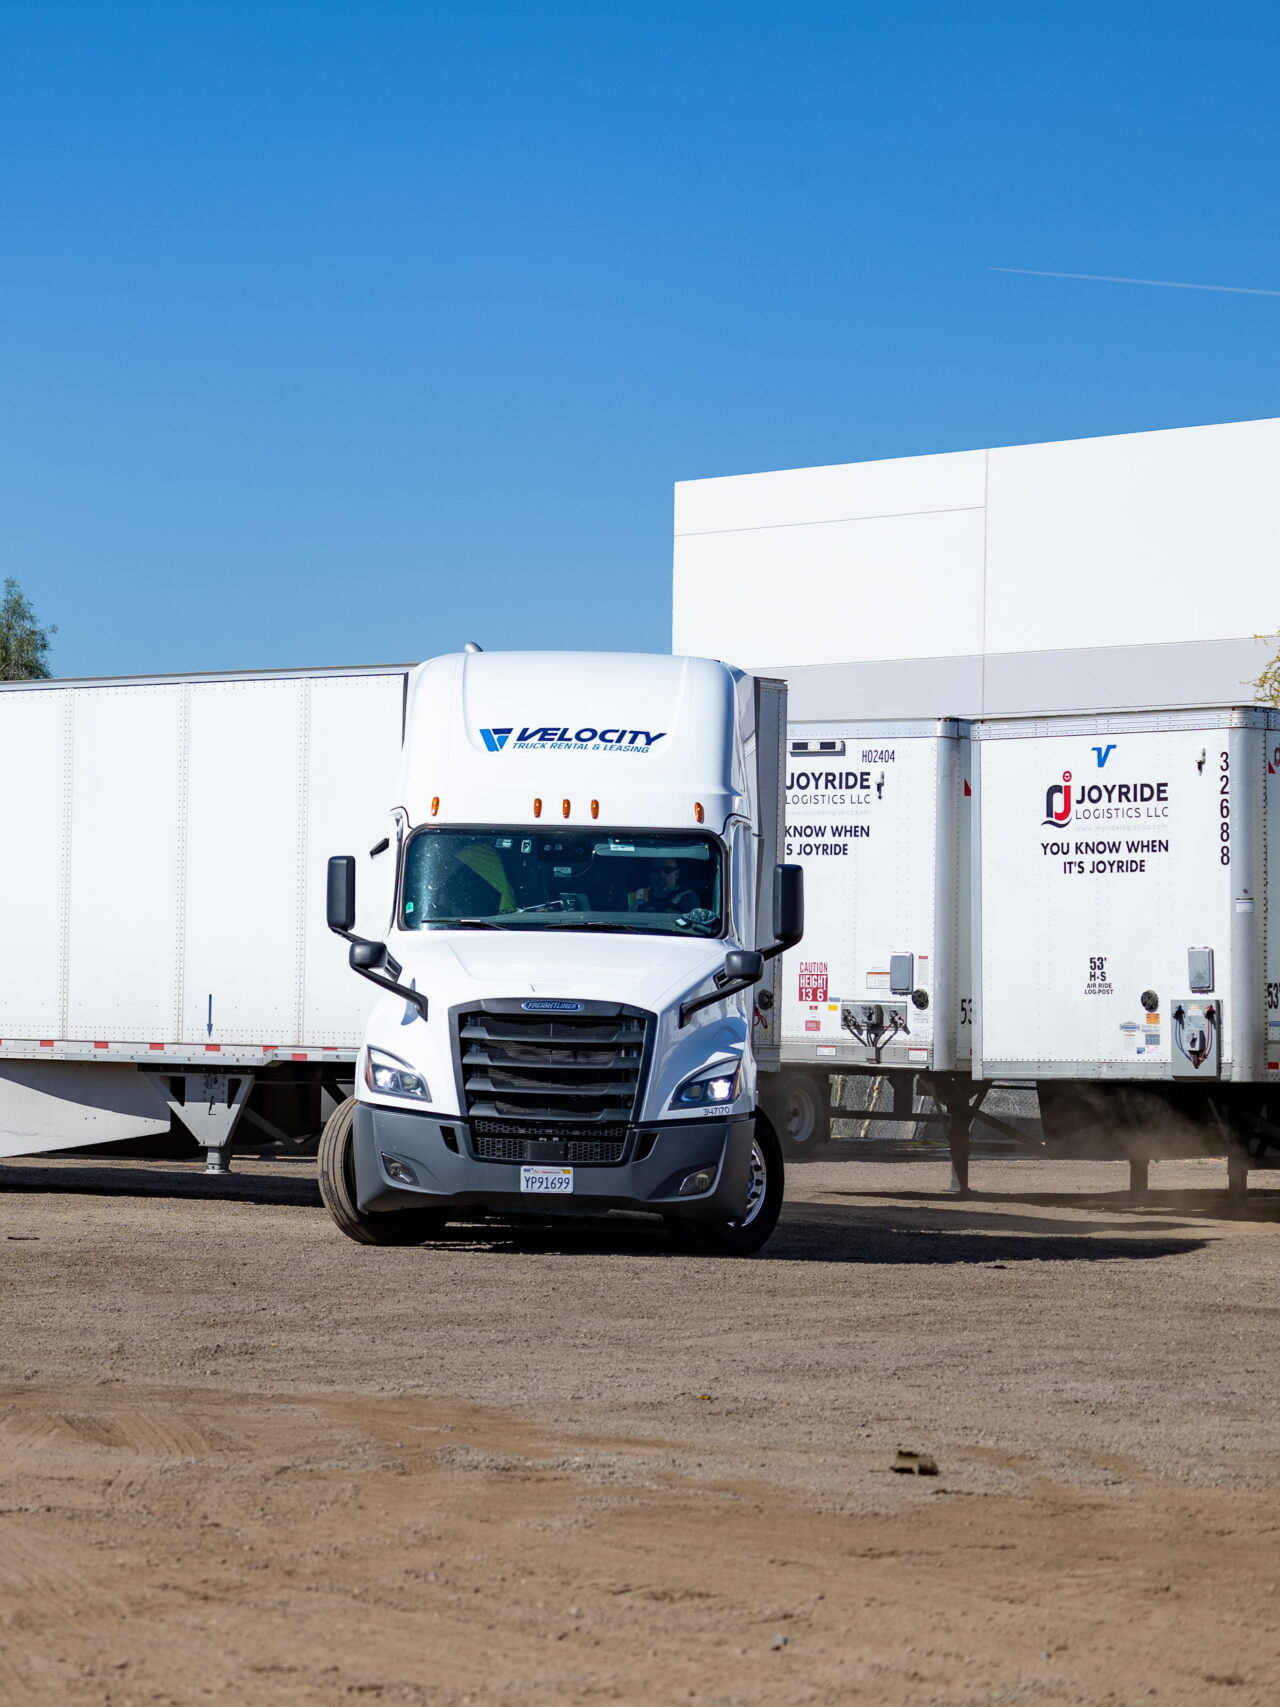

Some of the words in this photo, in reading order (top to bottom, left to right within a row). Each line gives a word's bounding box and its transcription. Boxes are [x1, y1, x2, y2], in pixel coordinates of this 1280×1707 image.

[516, 727, 668, 746] VELOCITY
[512, 742, 547, 750] TRUCK
[549, 742, 589, 751] RENTAL
[592, 743, 600, 751] &
[603, 744, 650, 754] LEASING
[786, 771, 871, 791] JOYRIDE
[786, 793, 846, 805] LOGISTICS
[850, 793, 871, 805] LLC
[1075, 782, 1169, 805] JOYRIDE
[1075, 807, 1142, 820] LOGISTICS
[1146, 806, 1169, 818] LLC
[785, 825, 827, 838] KNOW
[830, 825, 870, 838] WHEN
[797, 843, 848, 856] JOYRIDE
[1041, 842, 1070, 855] YOU
[1075, 841, 1121, 855] KNOW
[1126, 839, 1169, 853] WHEN
[1063, 861, 1084, 874] IT'S
[1089, 860, 1146, 874] JOYRIDE
[799, 961, 828, 973] CAUTION
[800, 974, 827, 988] HEIGHT
[527, 1002, 578, 1010] FREIGHTLINER
[524, 1176, 570, 1190] YP91699
